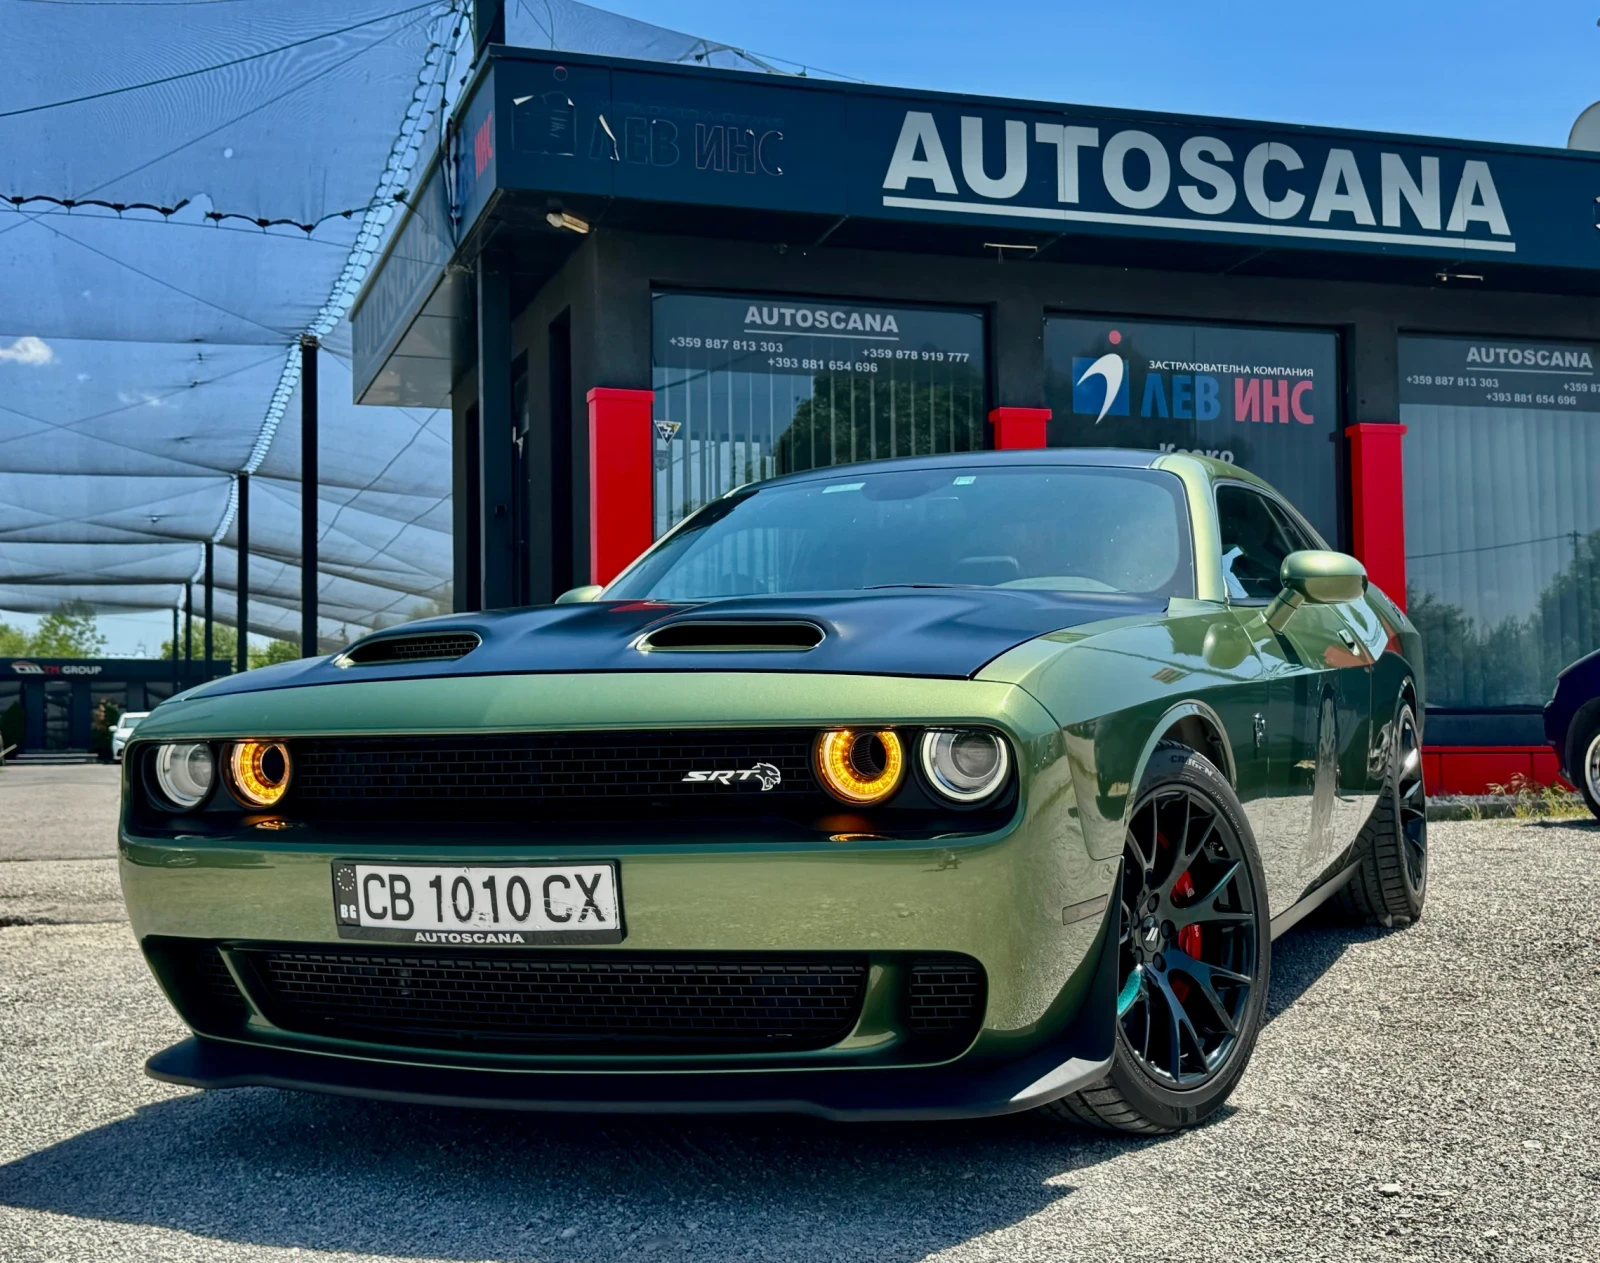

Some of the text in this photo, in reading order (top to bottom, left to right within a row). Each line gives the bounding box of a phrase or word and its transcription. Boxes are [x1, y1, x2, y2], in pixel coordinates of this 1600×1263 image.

[588, 114, 784, 177] ЛЕВ ИНС
[883, 111, 1511, 236] AUTOSCANA
[744, 306, 899, 333] AUTOSCANA
[669, 336, 784, 353] +359 887 813 303
[862, 348, 970, 363] +359 878 919 777
[1466, 347, 1593, 368] AUTOSCANA
[768, 358, 878, 373] +393 881 654 696
[1149, 360, 1314, 377] ЗАСТРАХОВАТЕЛНА КОМПАНИЯ
[1407, 375, 1499, 388] +359 887 813 303
[1563, 382, 1588, 392] +359
[1140, 373, 1314, 424] ЛЕВ ИНС
[1486, 393, 1577, 405] +393 881 654 696
[62, 665, 102, 675] GROUP
[682, 770, 761, 785] SRT
[363, 873, 606, 924] CB 1010 CX
[340, 904, 357, 919] BG
[414, 932, 525, 944] AUTOSCANA
